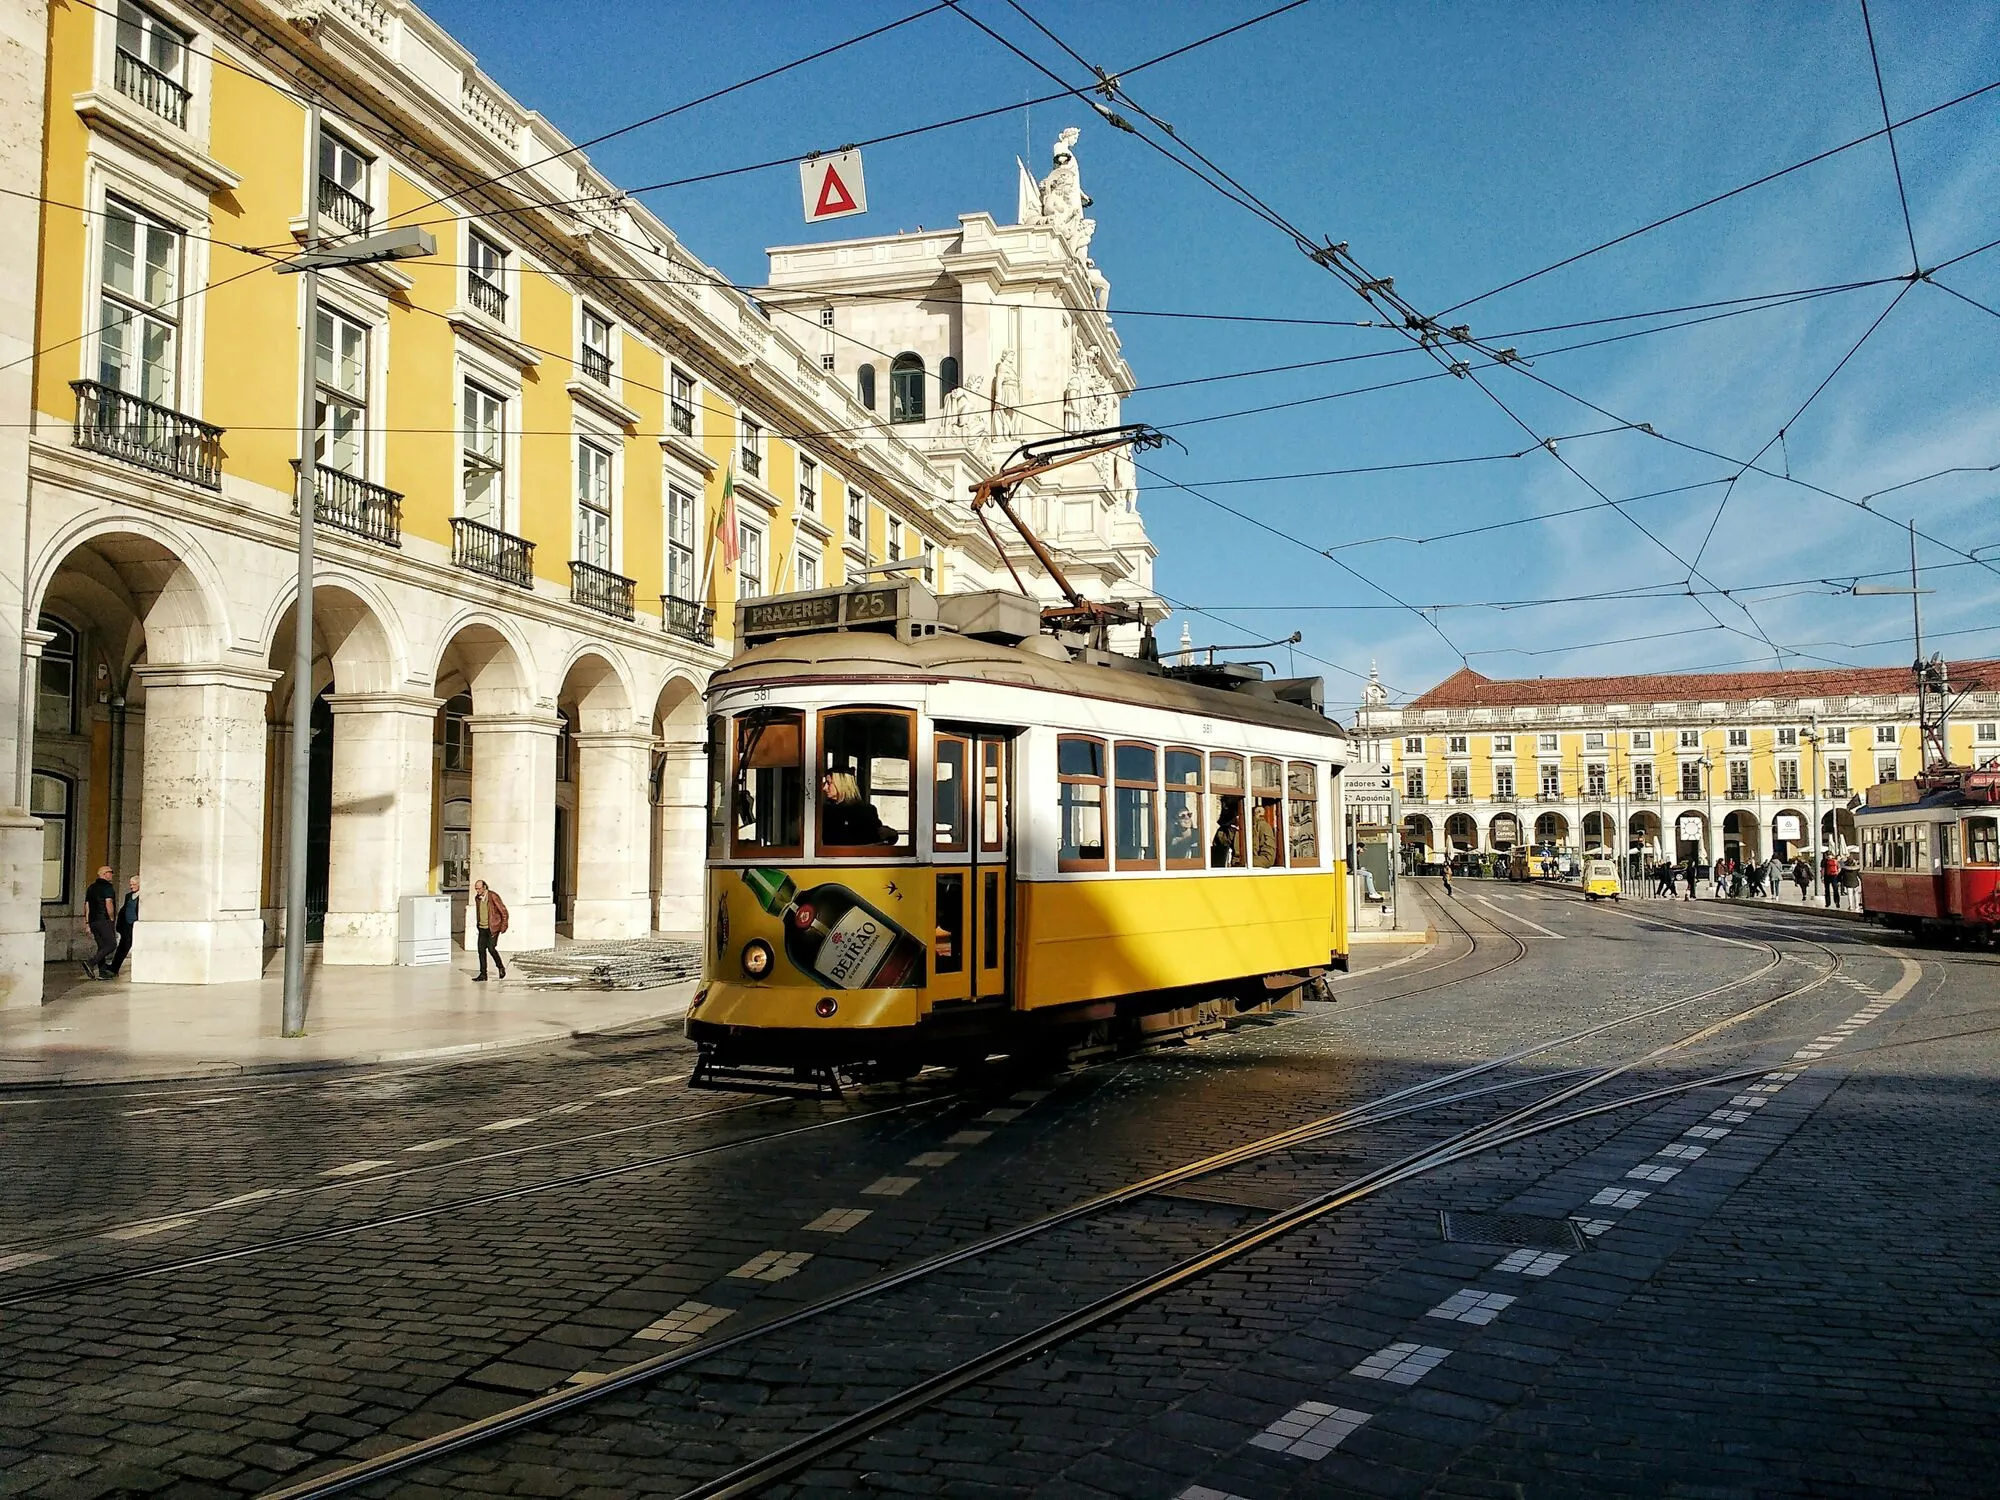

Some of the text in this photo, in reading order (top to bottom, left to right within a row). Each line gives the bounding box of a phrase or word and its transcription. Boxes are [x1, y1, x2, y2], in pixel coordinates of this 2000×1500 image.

[752, 592, 885, 623] PRAZERES 25
[754, 689, 770, 701] 581
[831, 922, 876, 981] BEIRÃO
